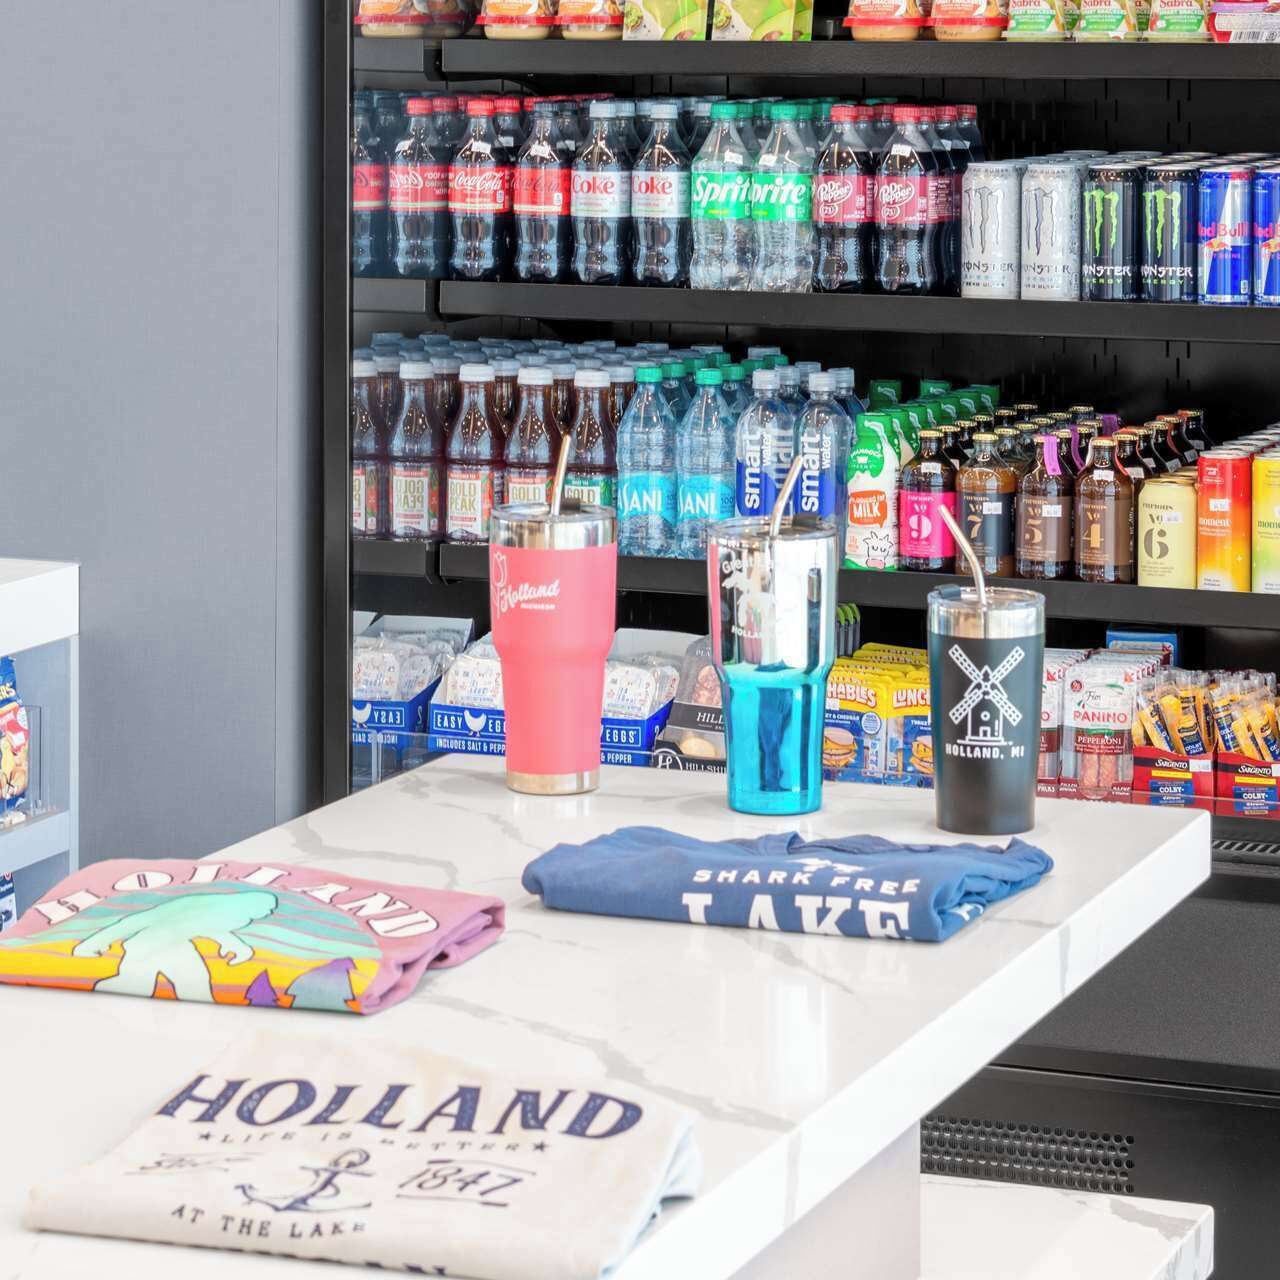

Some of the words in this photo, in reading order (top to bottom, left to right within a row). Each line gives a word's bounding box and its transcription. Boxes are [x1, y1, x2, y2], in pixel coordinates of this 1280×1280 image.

[572, 173, 616, 195] Coke
[632, 173, 673, 195] Coke
[818, 185, 851, 202] Pepper
[830, 179, 844, 189] Dr
[880, 185, 914, 202] Pepper
[892, 179, 906, 189] Dr
[763, 433, 771, 466] water
[821, 433, 831, 469] water
[744, 427, 761, 509] smart
[801, 431, 820, 511] smart
[450, 481, 477, 497] GOLD
[511, 486, 540, 499] GOLD
[450, 498, 477, 512] PEAK
[853, 502, 881, 518] MILK
[908, 514, 932, 540] 9
[967, 515, 982, 539] 7
[1024, 519, 1042, 544] 5
[1199, 517, 1231, 527] moment
[1082, 523, 1105, 548] 4
[1143, 527, 1169, 560] 6
[500, 580, 561, 612] Holland
[437, 715, 463, 729] EASY
[1073, 710, 1127, 724] PANINO
[436, 738, 465, 750] INCLUDES
[467, 740, 481, 751] SALT
[483, 741, 488, 751] &
[606, 726, 634, 744] EGGS
[1078, 735, 1122, 745] PEPPERONI
[607, 752, 632, 764] PEPPER
[945, 744, 1004, 760] HOLLAND,
[1011, 745, 1025, 758] MI
[1155, 759, 1188, 769] SARGENTO
[1239, 764, 1271, 776] SARGENTO
[692, 869, 812, 885] SHARK
[830, 877, 920, 895] FREE
[34, 863, 439, 937] HOLLAND
[682, 893, 912, 940] LAKE
[154, 1074, 643, 1139] HOLLAND
[399, 1166, 524, 1197] 1847
[171, 1204, 205, 1225] AT
[221, 1215, 272, 1239] THE
[290, 1222, 367, 1240] LAKE
